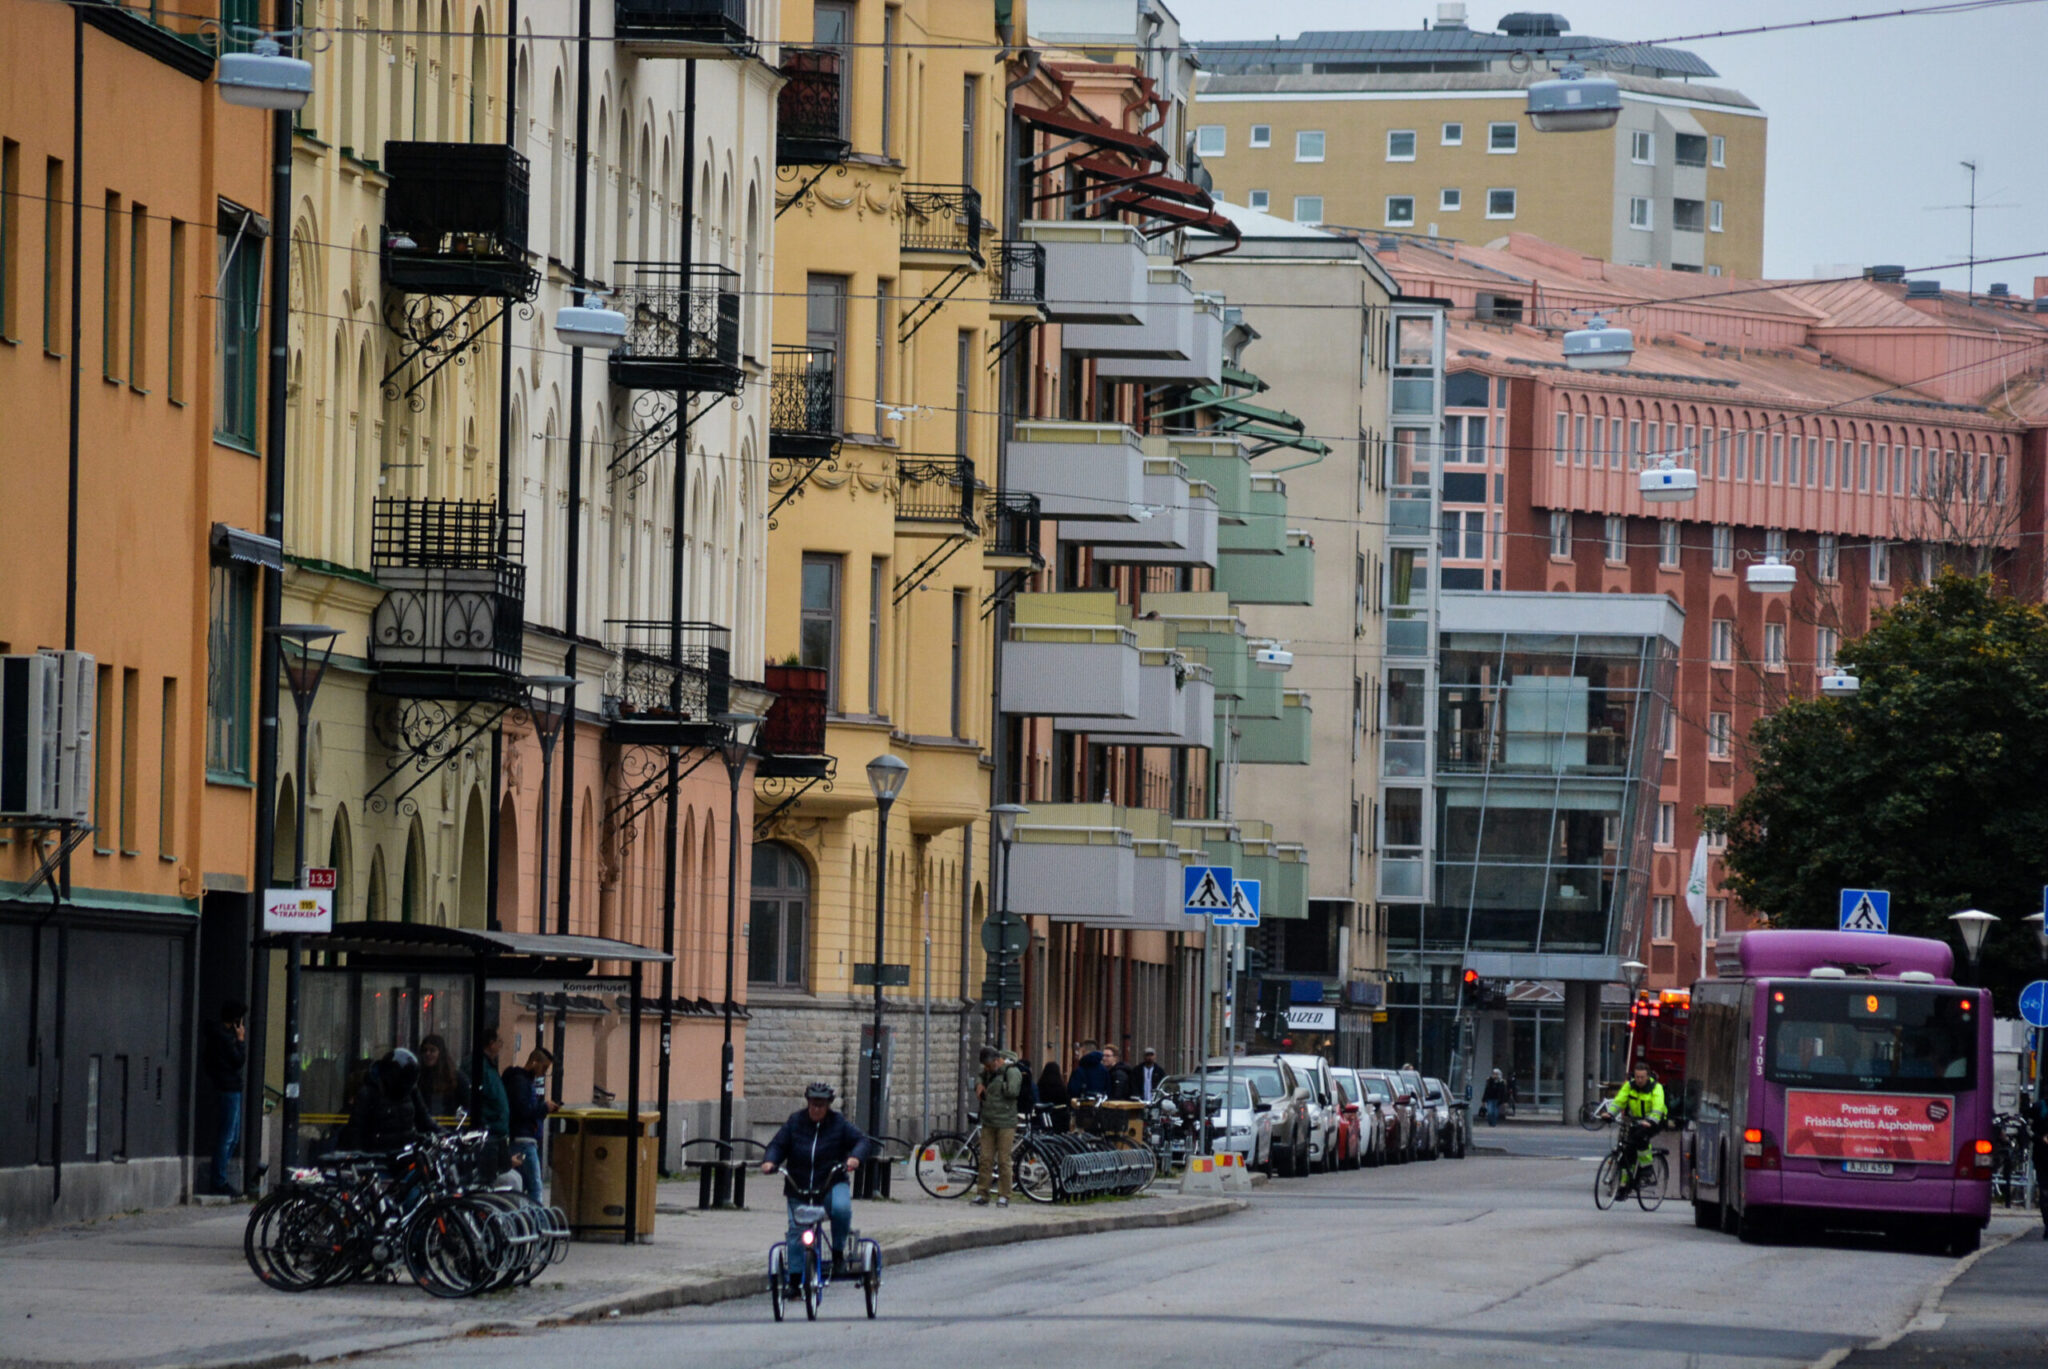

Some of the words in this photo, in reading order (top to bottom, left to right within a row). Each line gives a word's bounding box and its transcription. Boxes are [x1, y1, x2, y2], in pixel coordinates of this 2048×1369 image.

[311, 873, 332, 885] 13,3
[563, 982, 626, 992] Konserthuset
[1866, 995, 1879, 1013] 9
[1756, 1036, 1765, 1076] 7103
[1842, 1103, 1881, 1115] Premiär
[1883, 1105, 1899, 1116] för
[1805, 1116, 1876, 1129] Friskis&Svettis
[1878, 1119, 1935, 1132] Aspholmen
